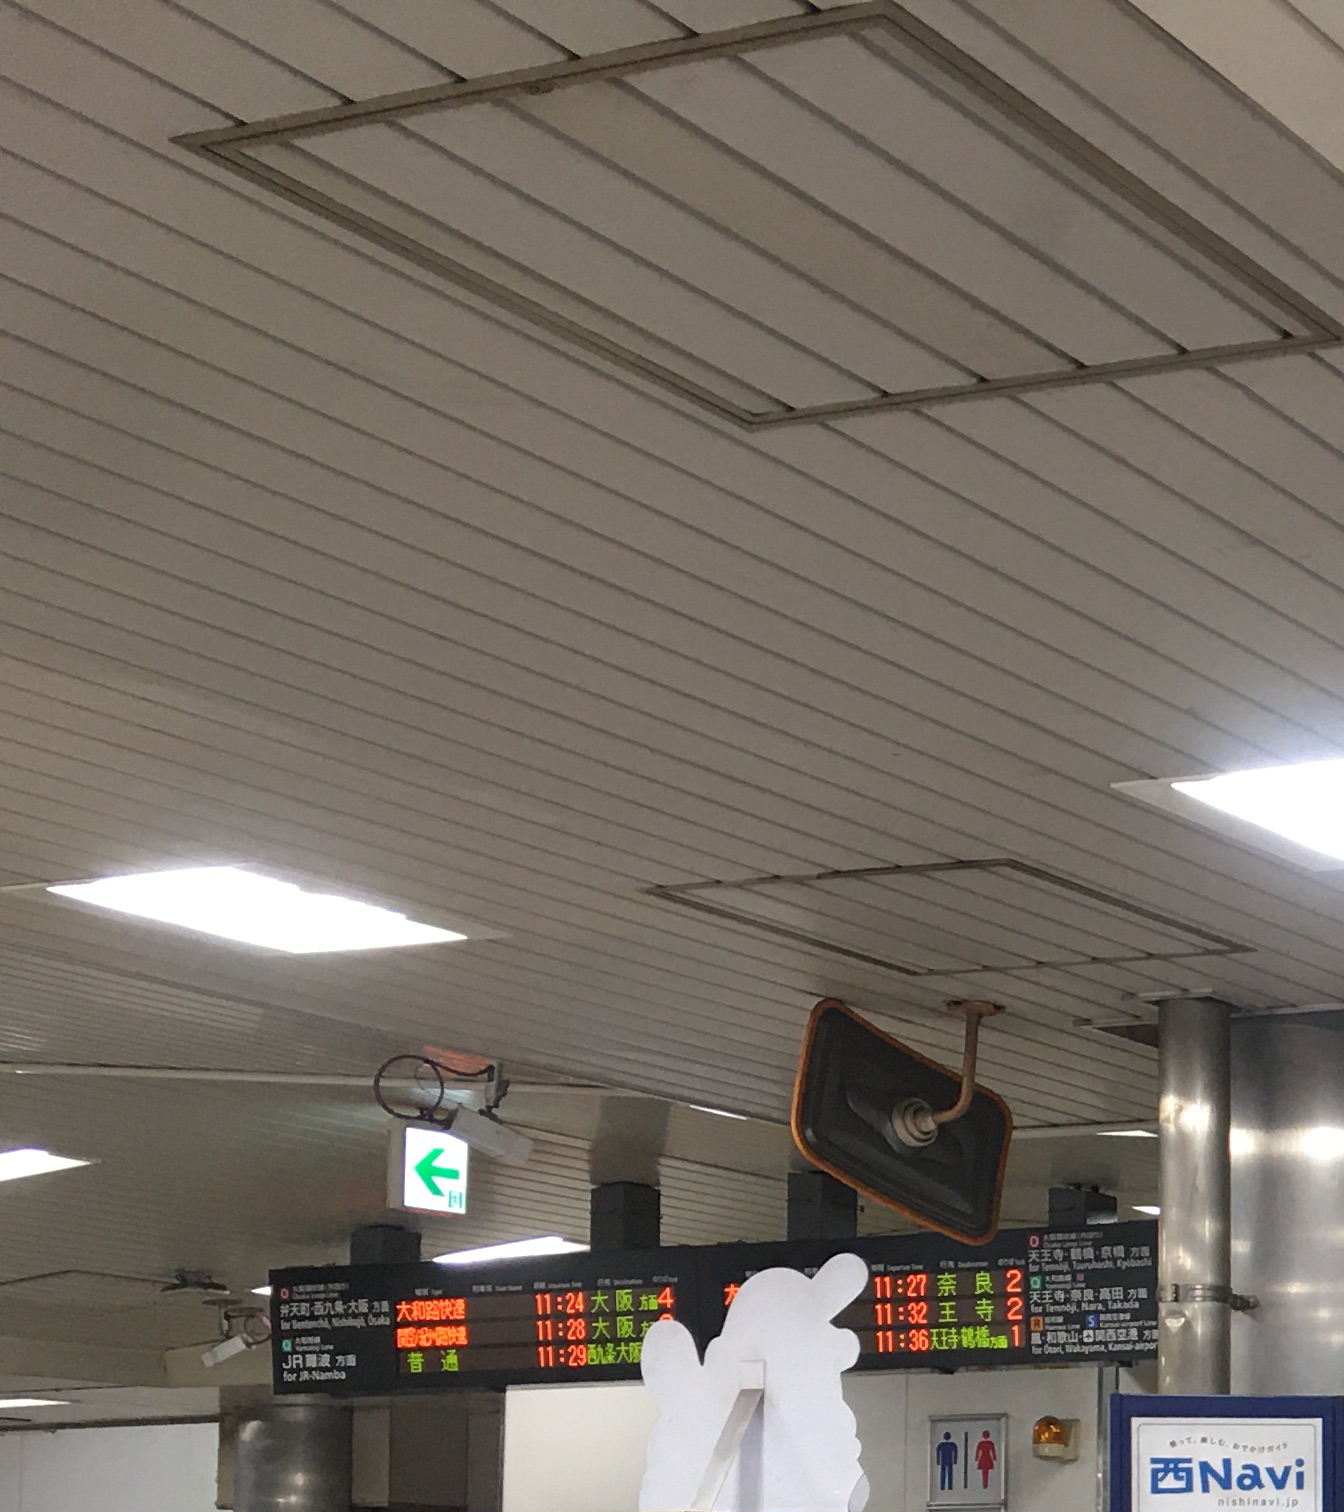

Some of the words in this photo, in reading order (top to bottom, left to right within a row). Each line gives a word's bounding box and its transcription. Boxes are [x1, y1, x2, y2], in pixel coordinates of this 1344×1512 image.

[1130, 1246, 1150, 1257] 方面
[874, 1273, 928, 1298] 11:27
[937, 1273, 994, 1296] 奈良
[1006, 1269, 1022, 1294] 2
[535, 1292, 584, 1315] 11:24
[657, 1286, 674, 1309] 4
[1128, 1288, 1148, 1299] 方面
[372, 1300, 389, 1312] 方面
[396, 1299, 466, 1322] 大和路快速
[875, 1302, 928, 1326] 11:32
[938, 1298, 994, 1323] 王寺
[1006, 1297, 1023, 1321] 2
[1031, 1304, 1042, 1313] for
[1108, 1301, 1139, 1309] Takada
[537, 1319, 586, 1342] 11:28
[876, 1329, 929, 1353] 11:36
[1012, 1325, 1021, 1347] 1
[336, 1354, 357, 1366] 方面
[407, 1349, 458, 1373] 普通
[538, 1345, 587, 1368] 11:29
[283, 1371, 297, 1381] for
[299, 1370, 346, 1381] JR-Namba
[1150, 1457, 1305, 1494] 西Navi
[1218, 1497, 1299, 1508] nishinavi.jp
